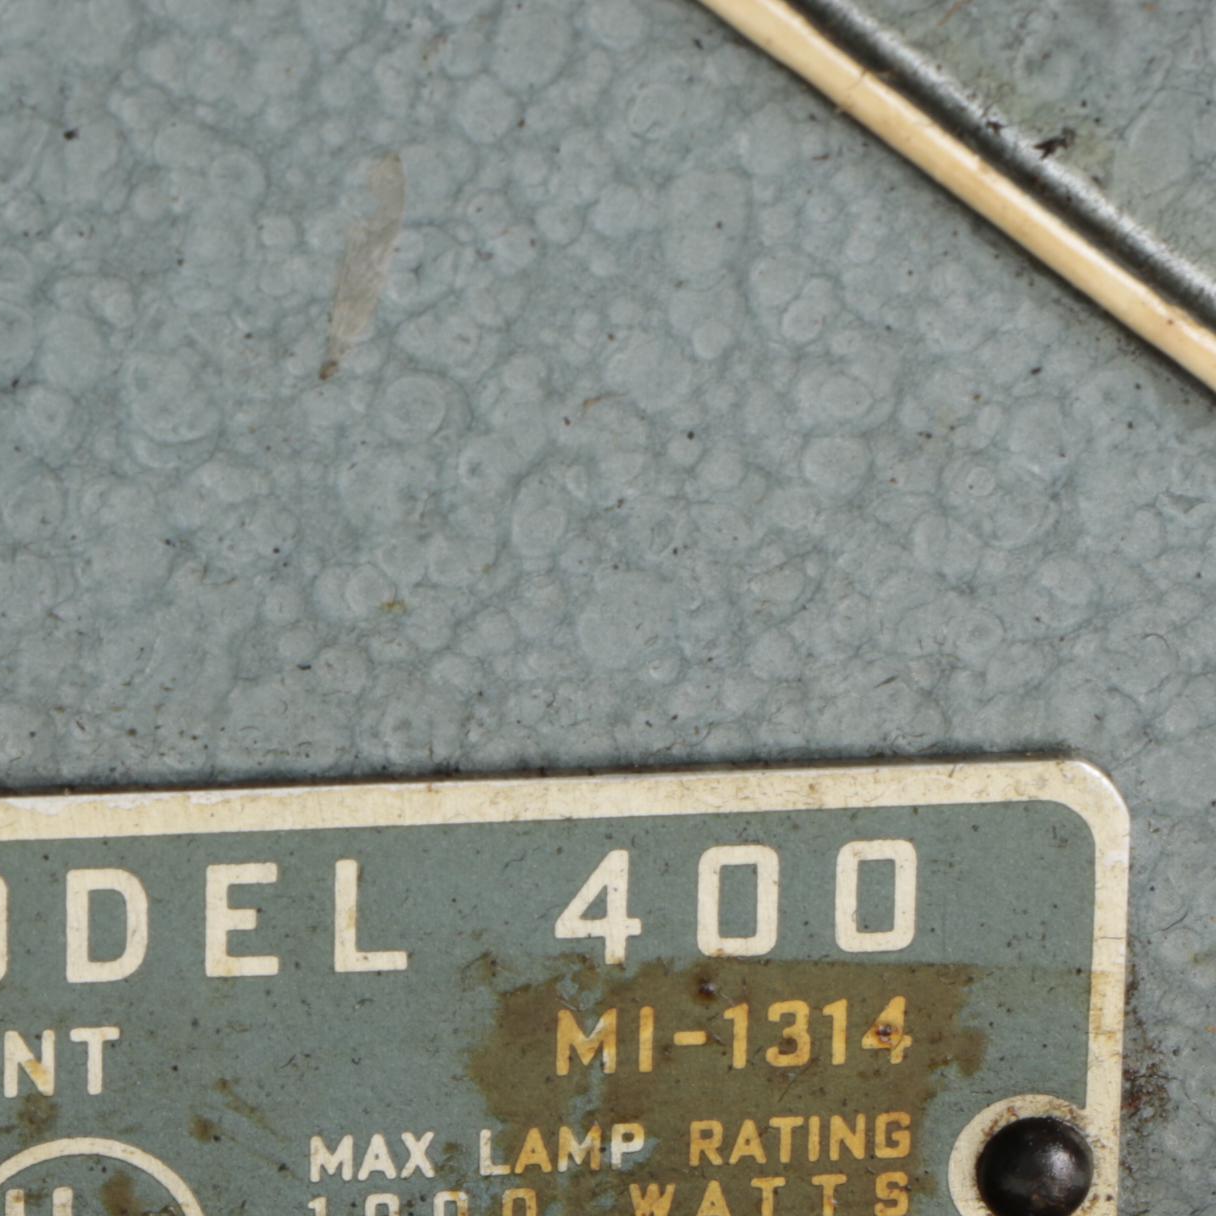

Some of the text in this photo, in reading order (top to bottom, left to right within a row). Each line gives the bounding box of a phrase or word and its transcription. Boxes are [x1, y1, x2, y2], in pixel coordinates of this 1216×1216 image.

[554, 839, 918, 965] 400
[555, 996, 913, 1076] MI-1314
[308, 1111, 912, 1183] MAX LAMP RATING
